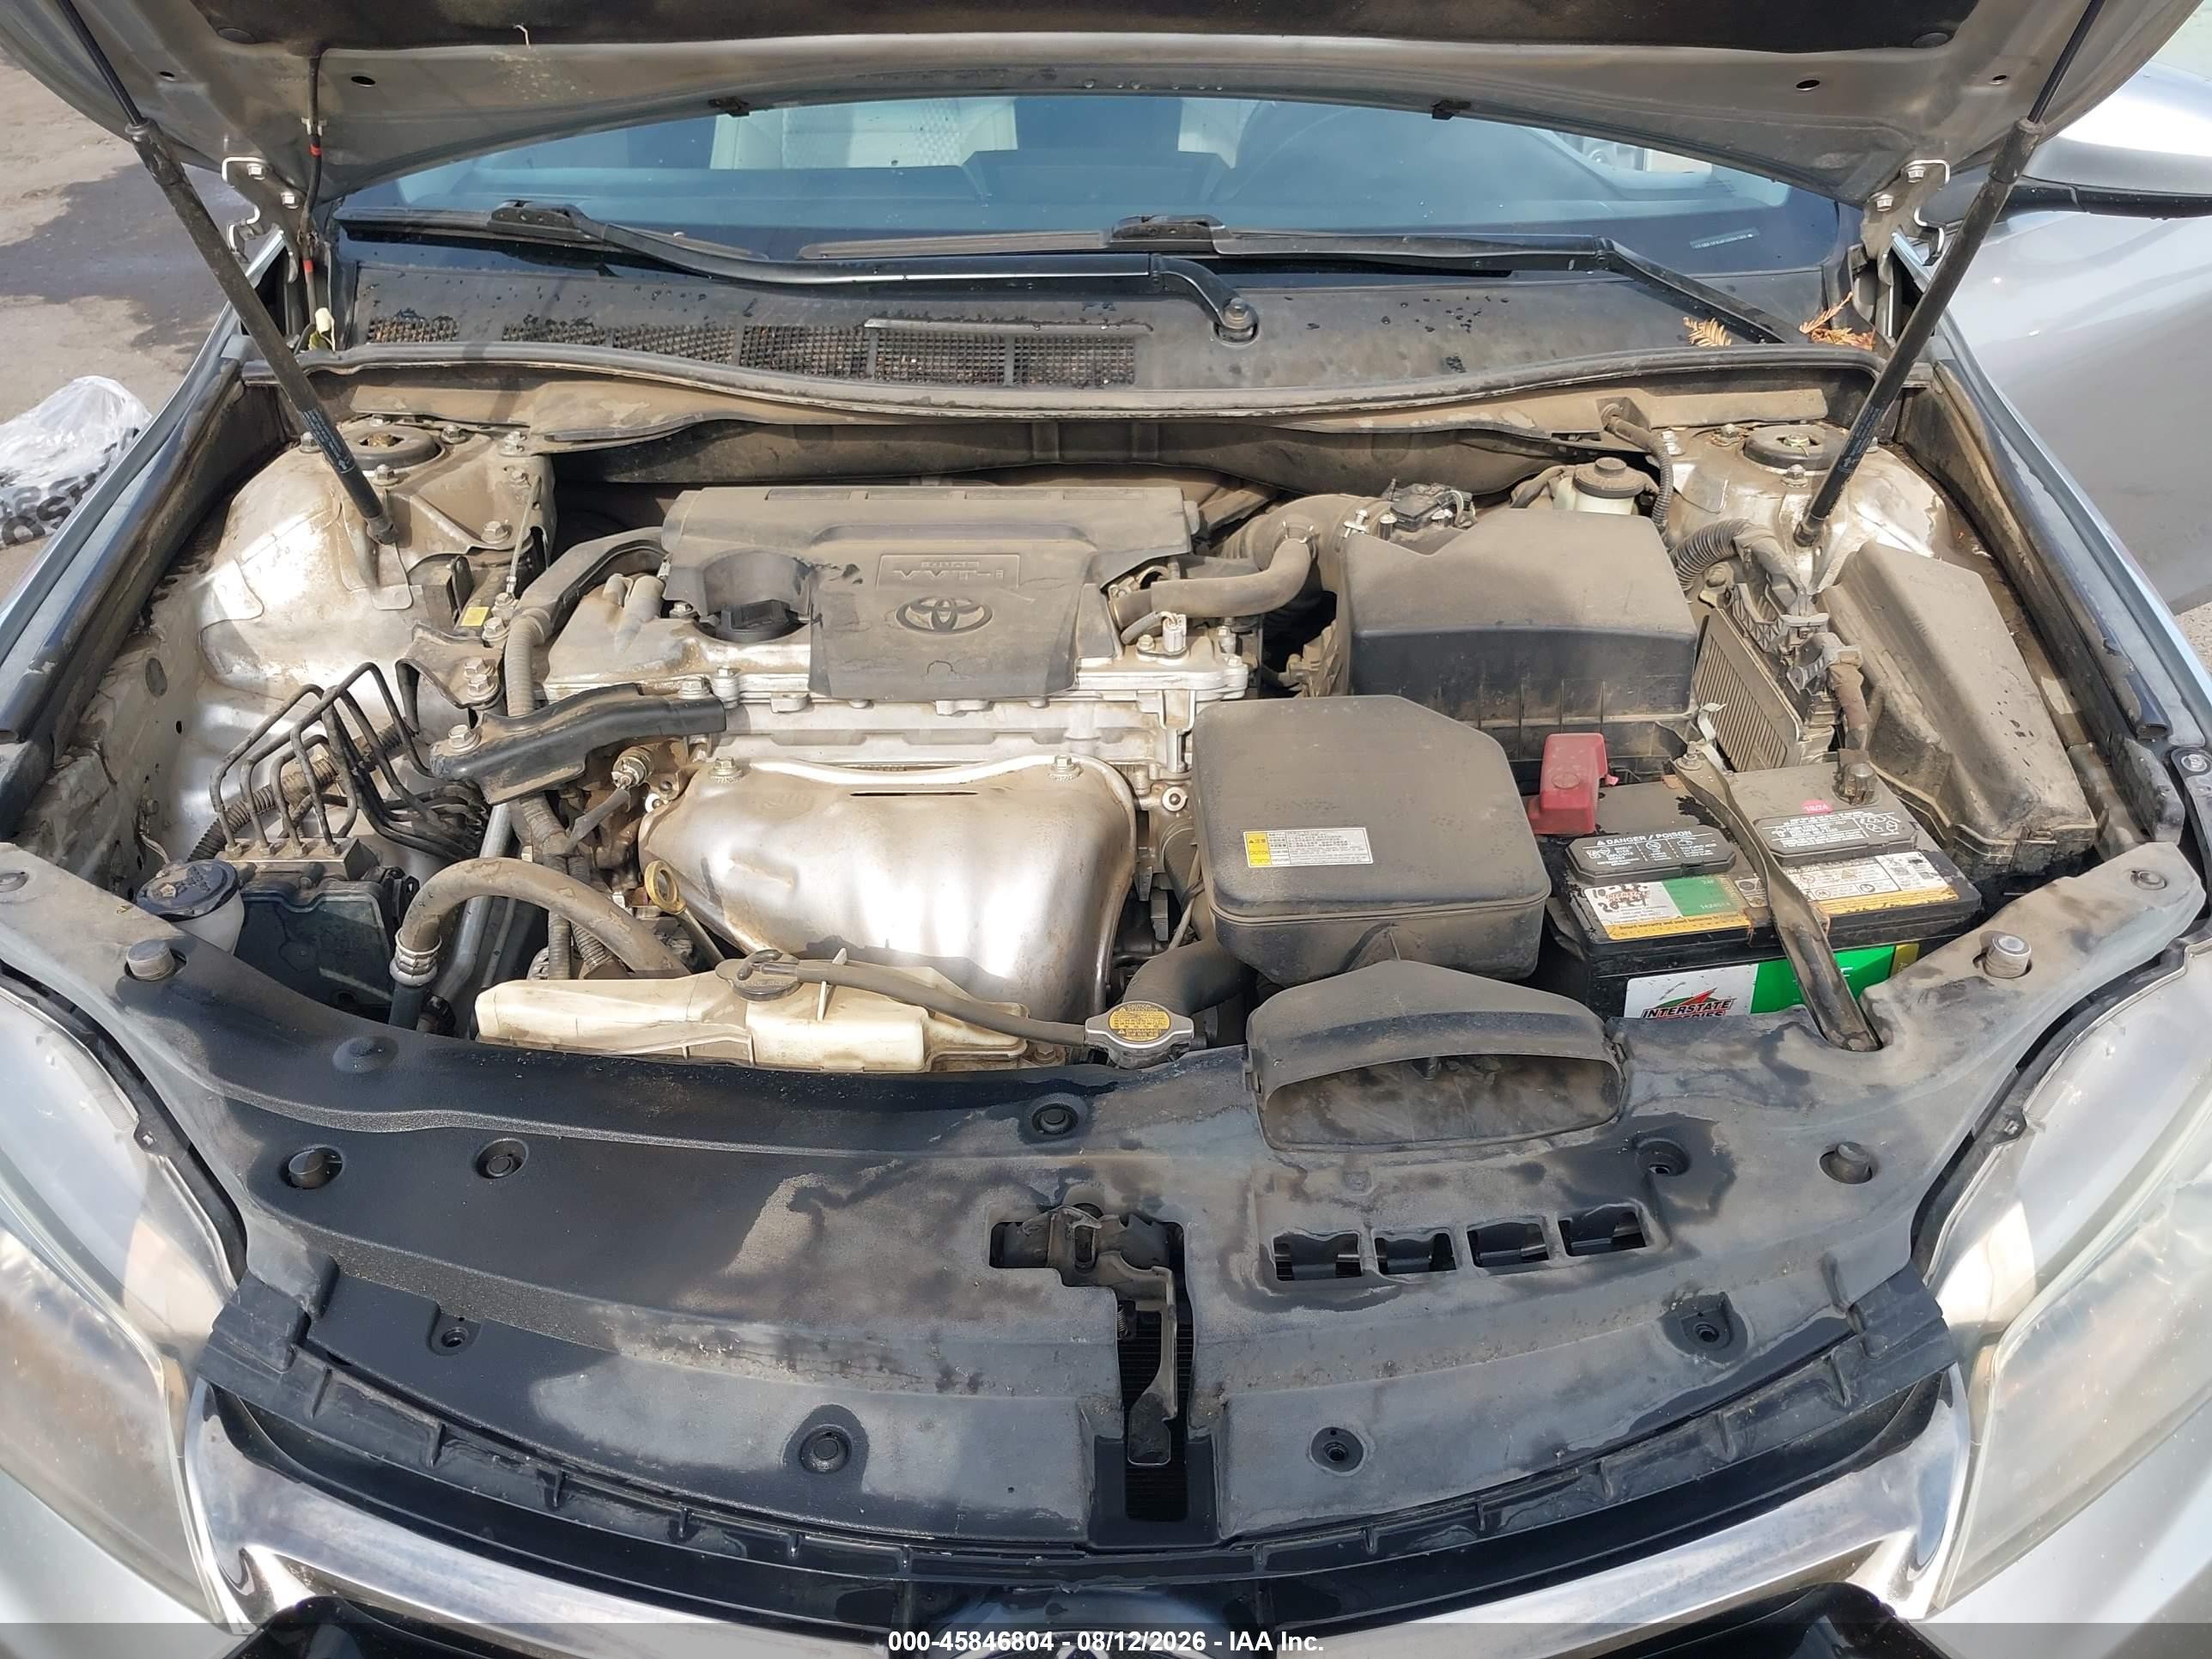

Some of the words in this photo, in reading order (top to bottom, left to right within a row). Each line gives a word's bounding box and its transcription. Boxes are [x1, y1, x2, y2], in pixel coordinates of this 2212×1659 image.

[1606, 836, 1646, 845] DANGER
[1656, 830, 1692, 840] POISON
[1642, 1000, 1733, 1018] INTERSTATE
